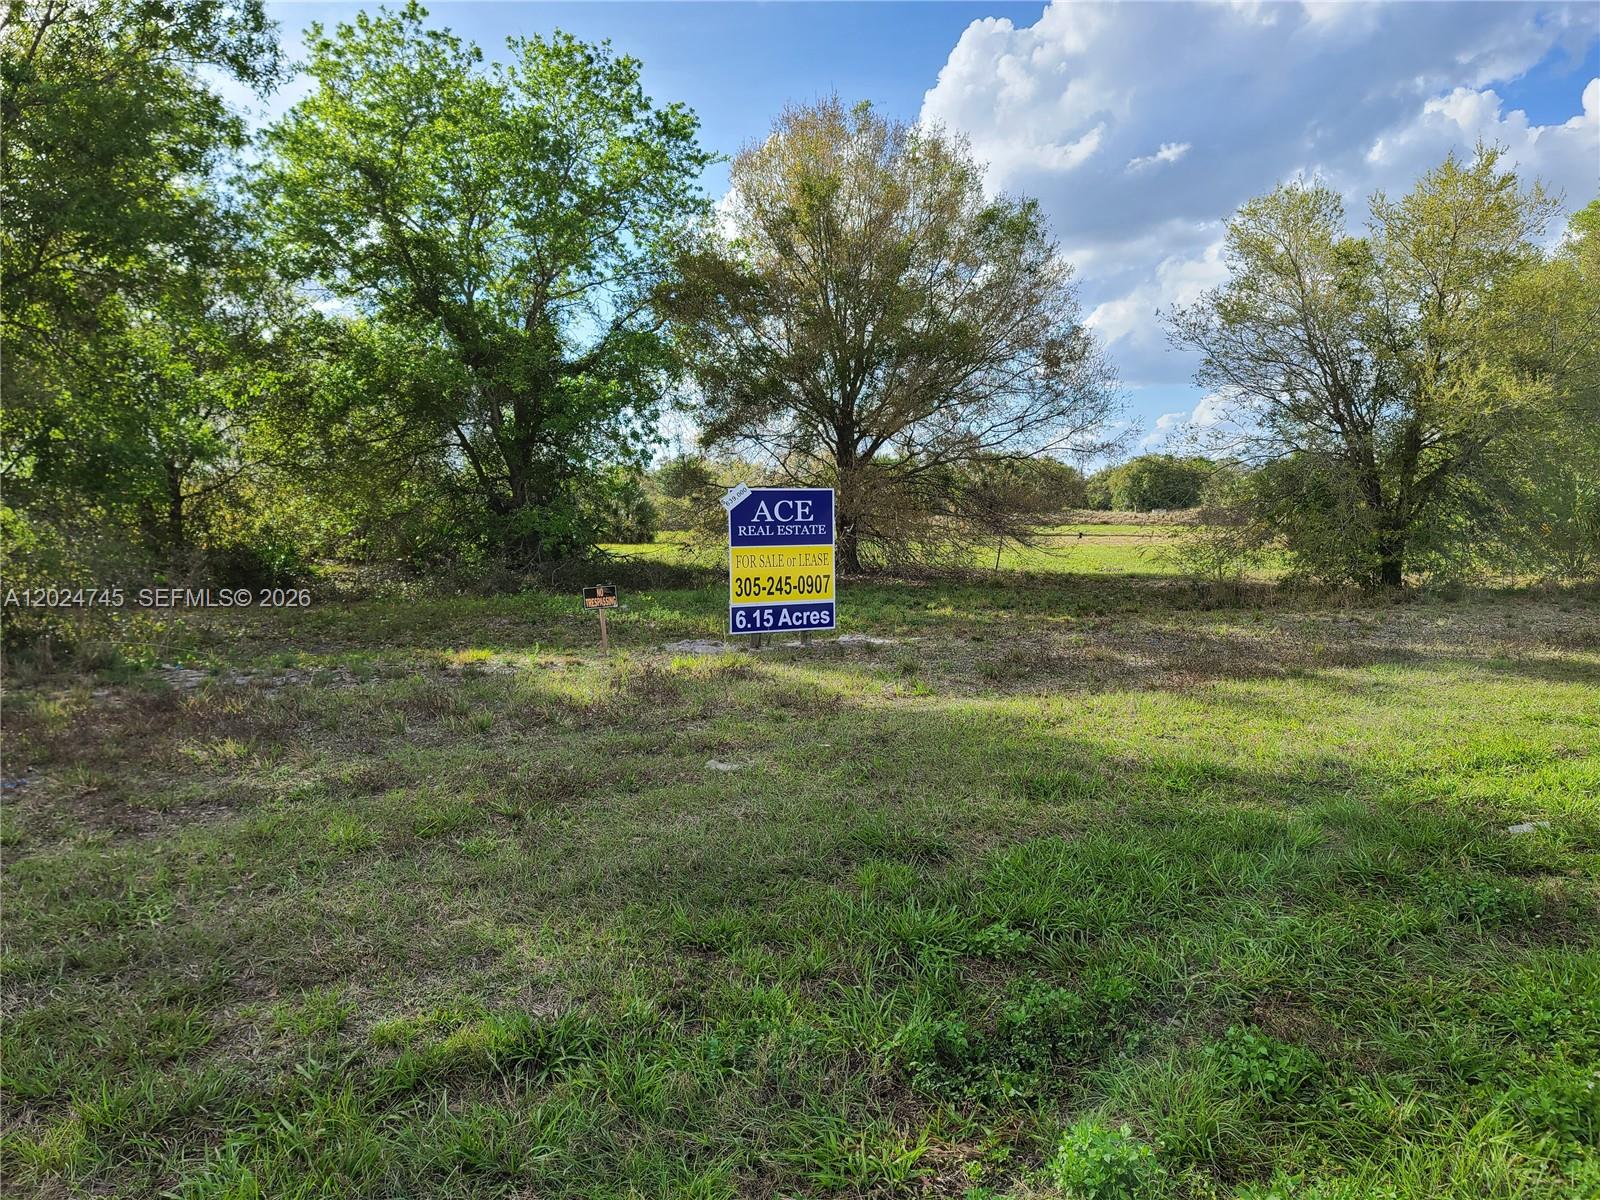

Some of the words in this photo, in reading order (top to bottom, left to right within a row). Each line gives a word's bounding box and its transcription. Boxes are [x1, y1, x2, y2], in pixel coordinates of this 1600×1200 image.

[751, 500, 814, 522] ACE
[738, 526, 774, 536] REAL
[777, 525, 826, 535] ESTATE
[736, 555, 756, 568] FOR
[760, 554, 784, 568] SALE
[787, 556, 796, 567] or
[799, 553, 829, 566] LEASE
[735, 575, 830, 597] 305-245-0907
[736, 609, 773, 628] 6.15
[778, 608, 830, 626] Acres
